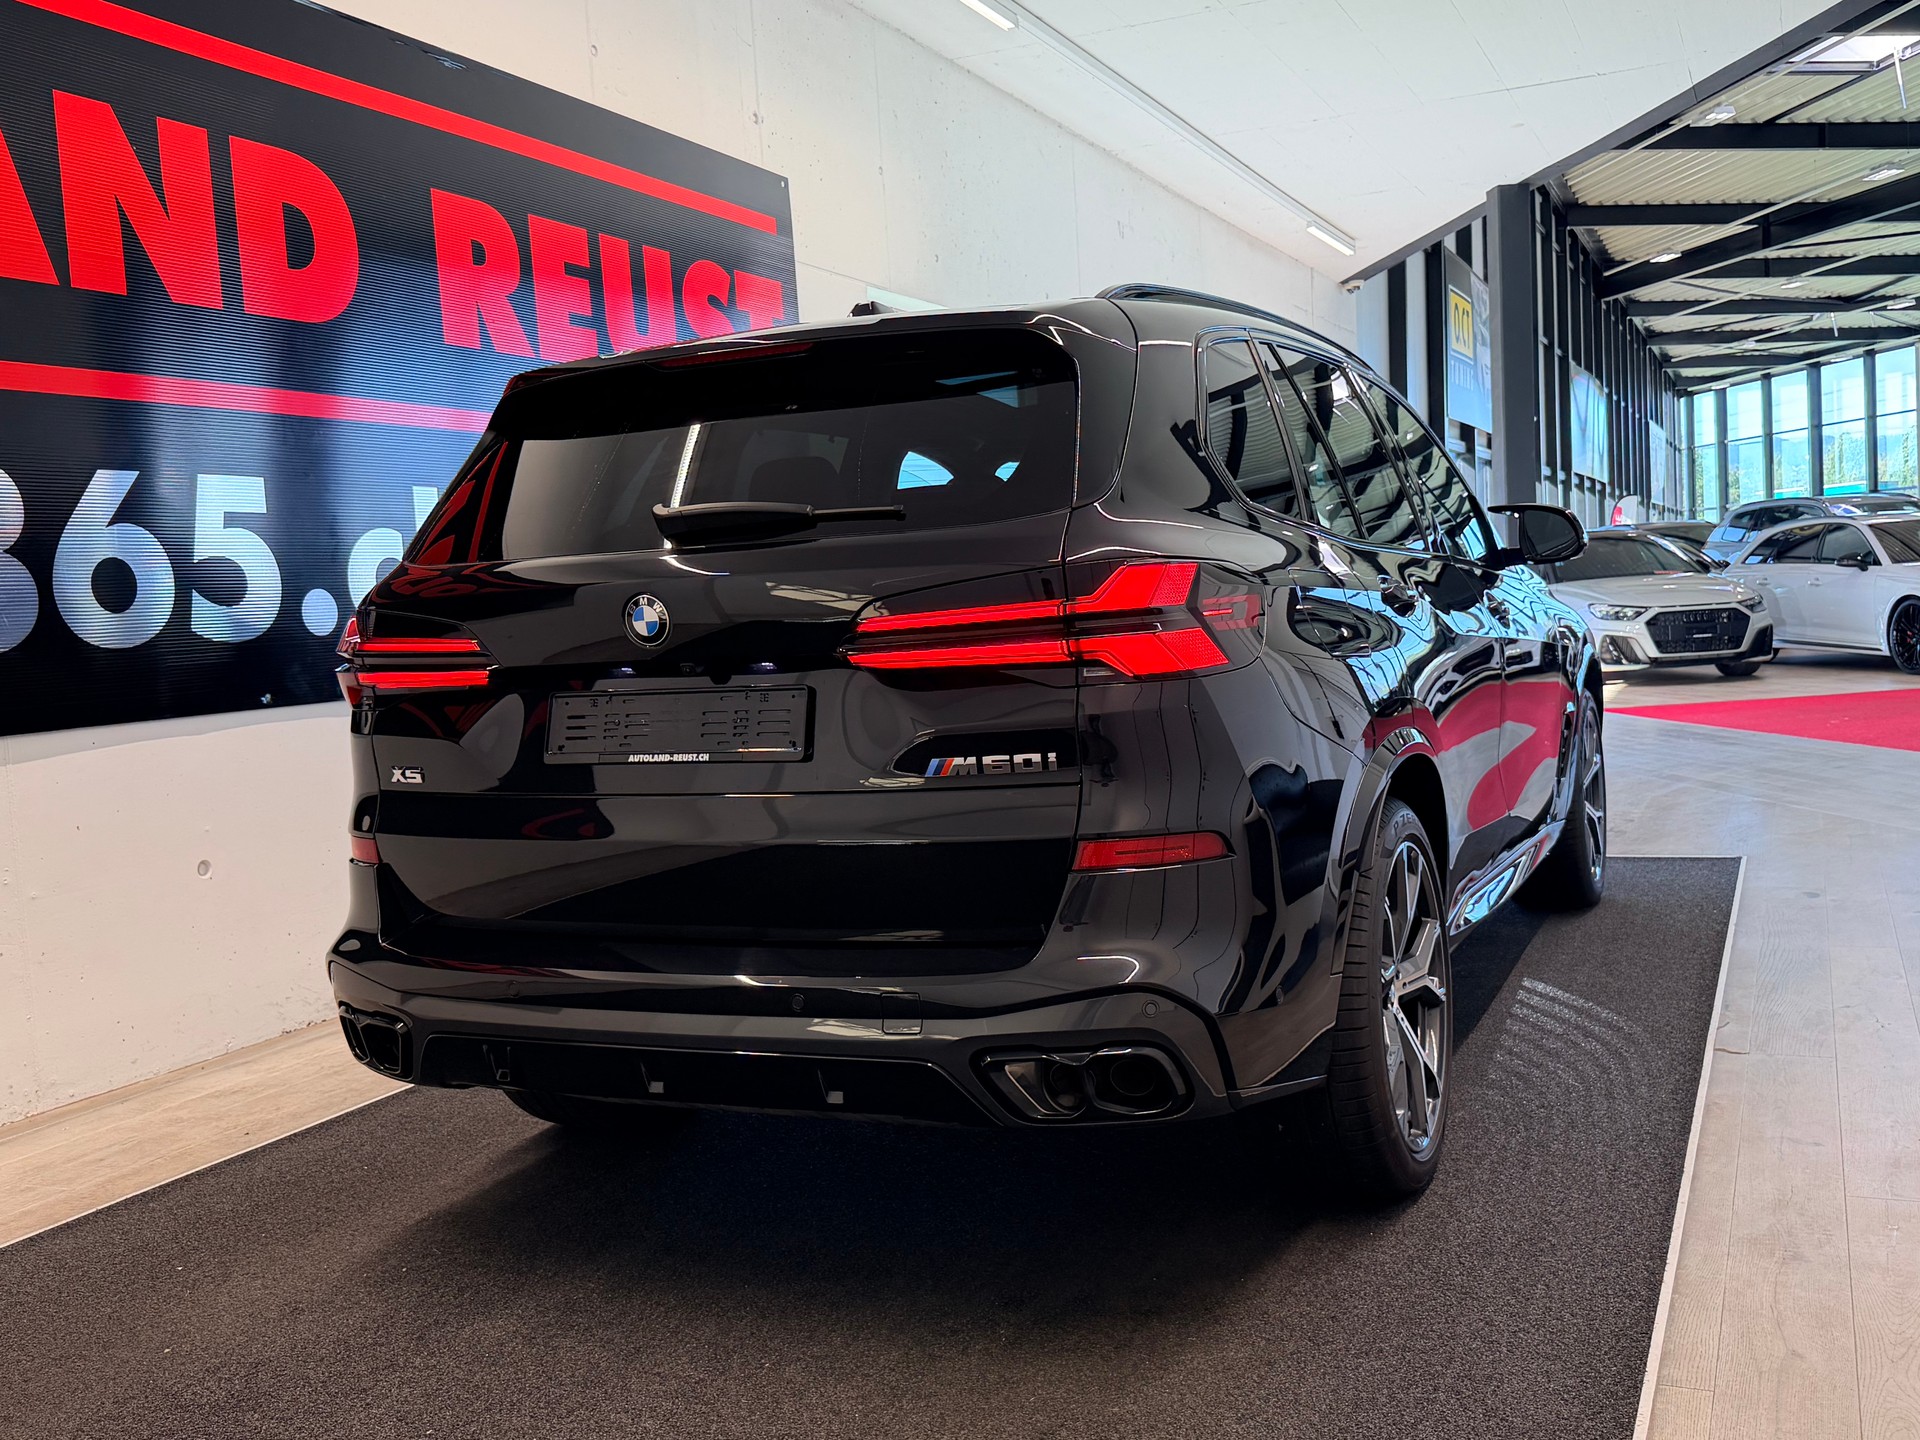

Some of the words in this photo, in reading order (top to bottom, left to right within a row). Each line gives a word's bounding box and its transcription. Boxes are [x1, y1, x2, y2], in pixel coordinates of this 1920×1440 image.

[0, 468, 439, 653] 65.c
[628, 597, 663, 614] BMW
[627, 753, 710, 762] AUTOLAND-REUST.CH
[947, 752, 1058, 776] M60i
[391, 766, 423, 784] X5
